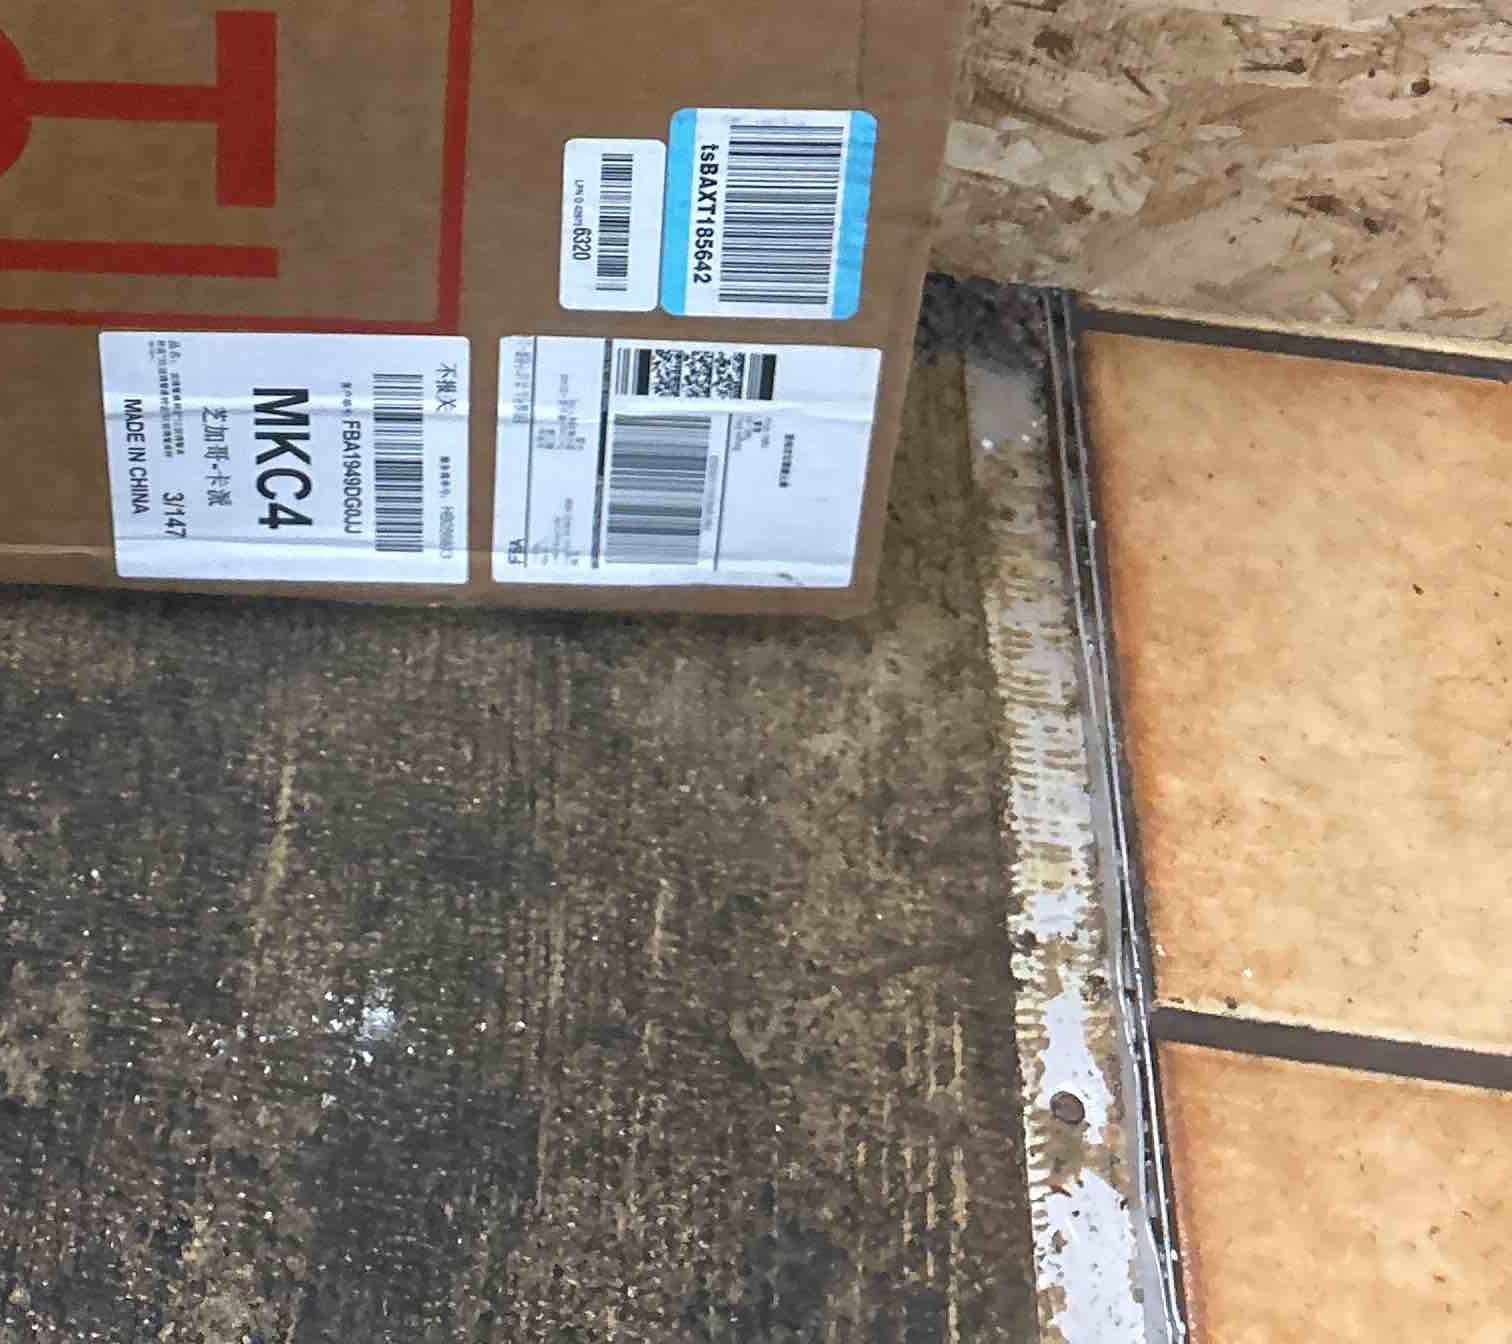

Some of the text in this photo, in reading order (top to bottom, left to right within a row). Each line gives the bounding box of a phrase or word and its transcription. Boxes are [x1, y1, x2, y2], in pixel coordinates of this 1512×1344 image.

[693, 143, 720, 285] tsBAXT185642
[123, 398, 151, 515] MADE IN CHINA
[162, 491, 187, 539] 3/147
[252, 387, 313, 530] MKC4
